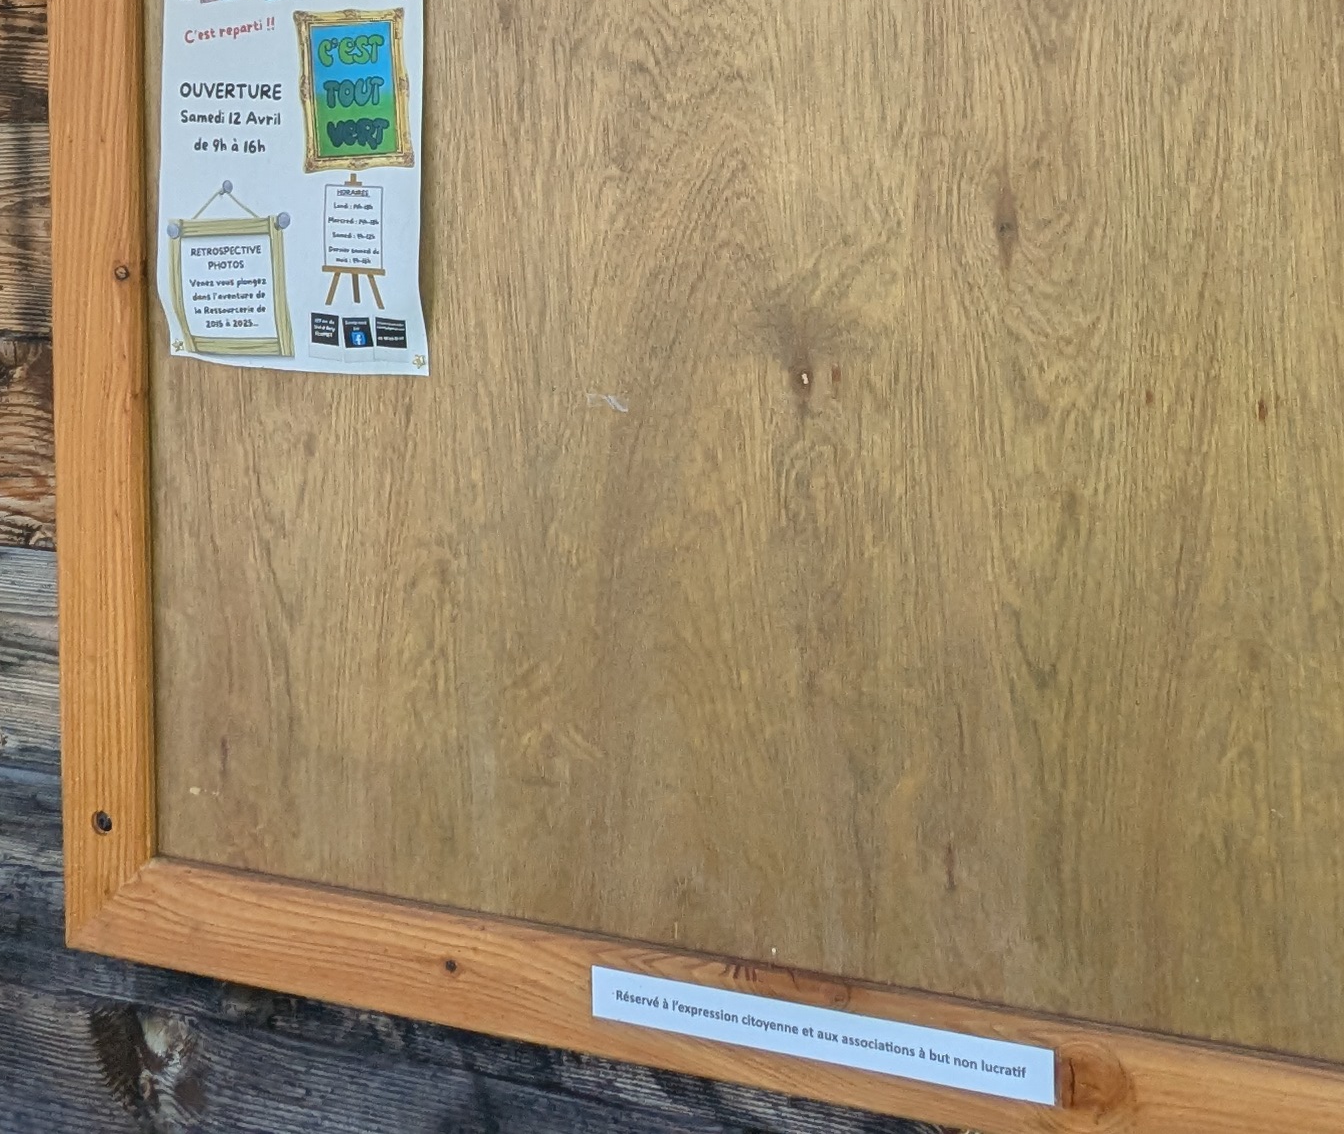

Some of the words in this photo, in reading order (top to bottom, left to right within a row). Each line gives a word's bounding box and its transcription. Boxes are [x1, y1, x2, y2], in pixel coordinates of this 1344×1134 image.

[184, 28, 216, 44] C'est
[219, 19, 263, 40] reparti
[179, 81, 283, 100] OUVERTURE
[323, 76, 385, 108] TOUT
[180, 109, 225, 125] Samedi
[229, 112, 242, 126] 12
[245, 111, 282, 126] Avril
[193, 137, 208, 152] de
[212, 138, 228, 152] 9h
[231, 137, 239, 152] à
[243, 138, 266, 153] 16h
[190, 245, 262, 257] RETROSPECTIVE
[207, 260, 245, 270] PHOTOS
[189, 278, 214, 287] Venez
[216, 279, 235, 287] vous
[236, 277, 267, 289] plongez
[192, 292, 211, 302] dans
[255, 290, 266, 300] de
[203, 305, 255, 315] Ressourcerie
[256, 304, 267, 314] de
[205, 319, 224, 329] 2015
[615, 989, 659, 1008] Réservé
[662, 997, 669, 1010] à
[672, 999, 739, 1024] l'expression
[741, 1014, 799, 1036] citoyenne
[802, 1026, 814, 1039] et
[817, 1031, 839, 1043] aux
[841, 1035, 916, 1058] associations
[918, 1047, 926, 1060] à
[929, 1048, 951, 1065] but
[953, 1057, 978, 1070] non
[981, 1059, 1027, 1079] lucratif
